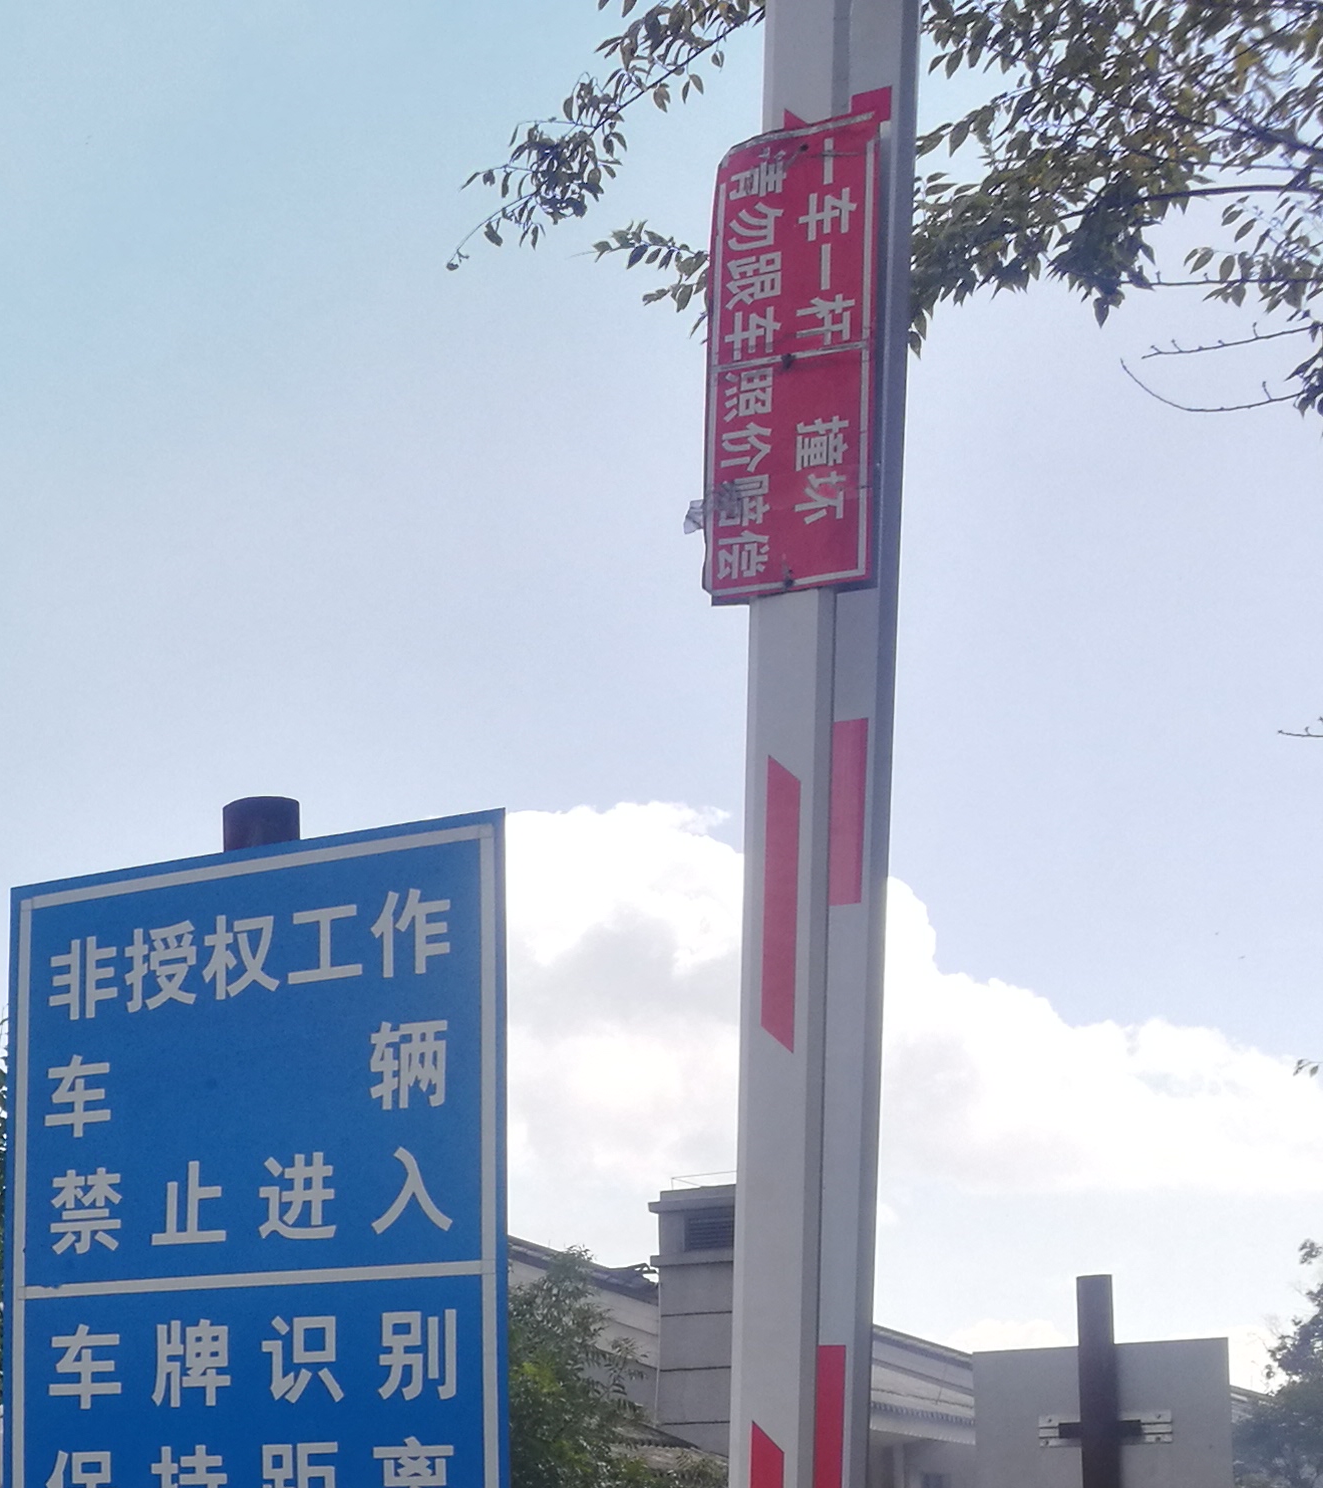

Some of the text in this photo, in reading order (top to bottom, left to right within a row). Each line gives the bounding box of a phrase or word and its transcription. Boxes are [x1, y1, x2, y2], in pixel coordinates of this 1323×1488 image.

[794, 137, 857, 526] 一车一杆 撞坏
[48, 888, 452, 1021] 非授权工作
[44, 1019, 448, 1138] 车 辆
[49, 1146, 453, 1255] 禁止进入
[47, 1308, 457, 1411] 车牌识别
